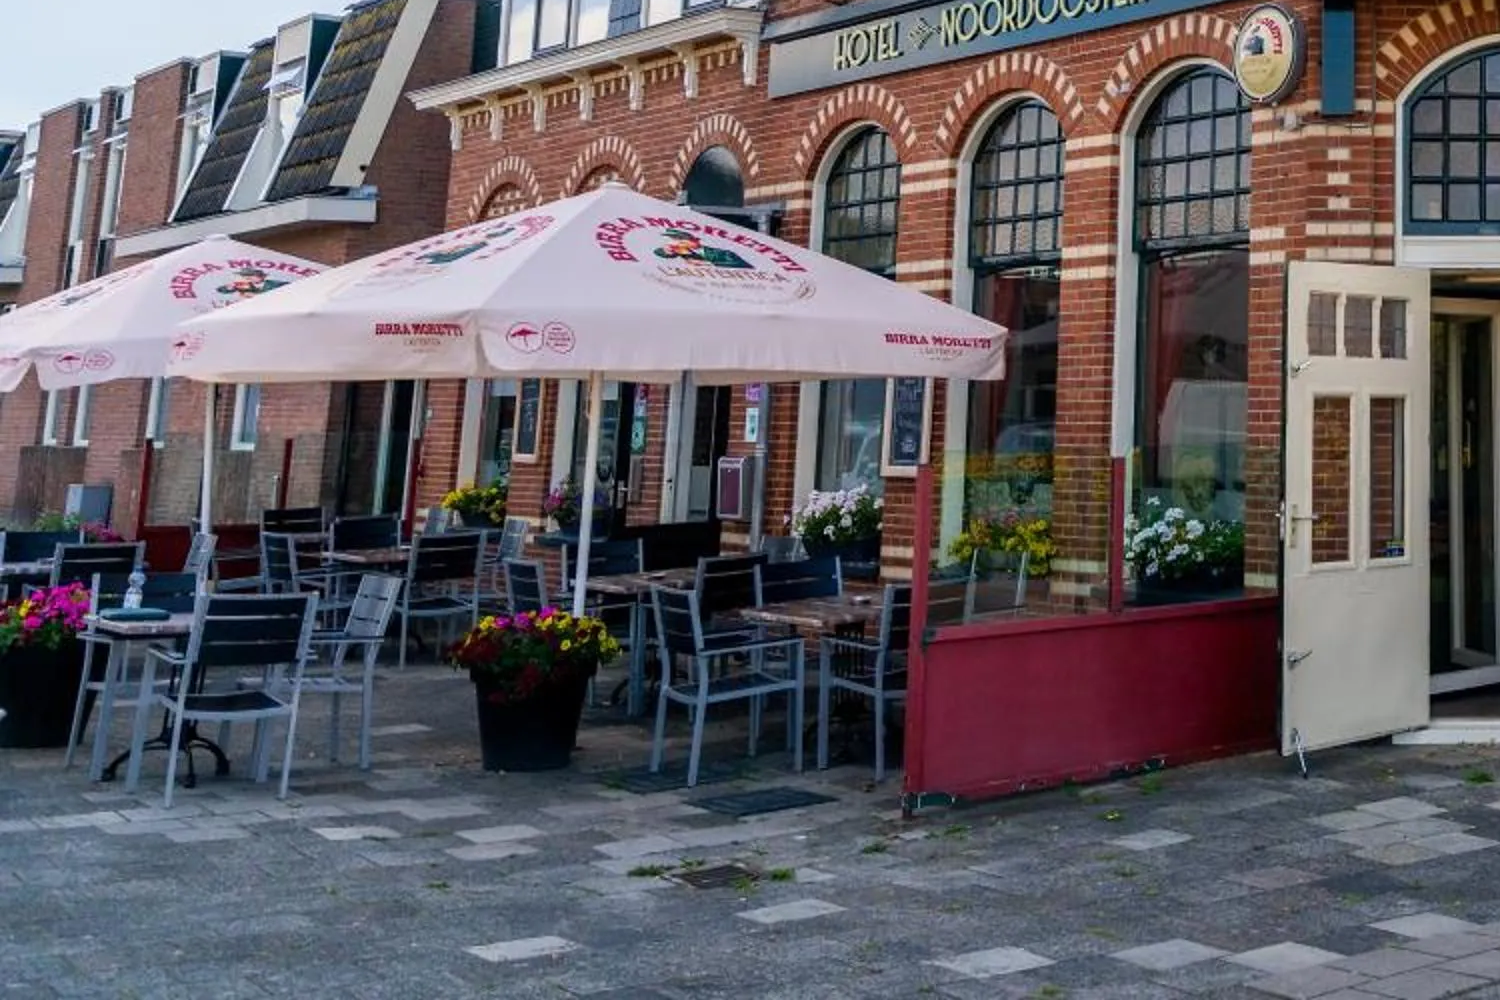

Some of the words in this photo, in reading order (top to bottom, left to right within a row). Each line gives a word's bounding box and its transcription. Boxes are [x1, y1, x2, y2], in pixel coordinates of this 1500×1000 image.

[833, 21, 903, 71] HOTEL
[596, 215, 646, 263] BIRRA
[641, 216, 807, 272] MORETTI
[169, 262, 223, 300] BIRRA
[227, 258, 321, 277] MORE
